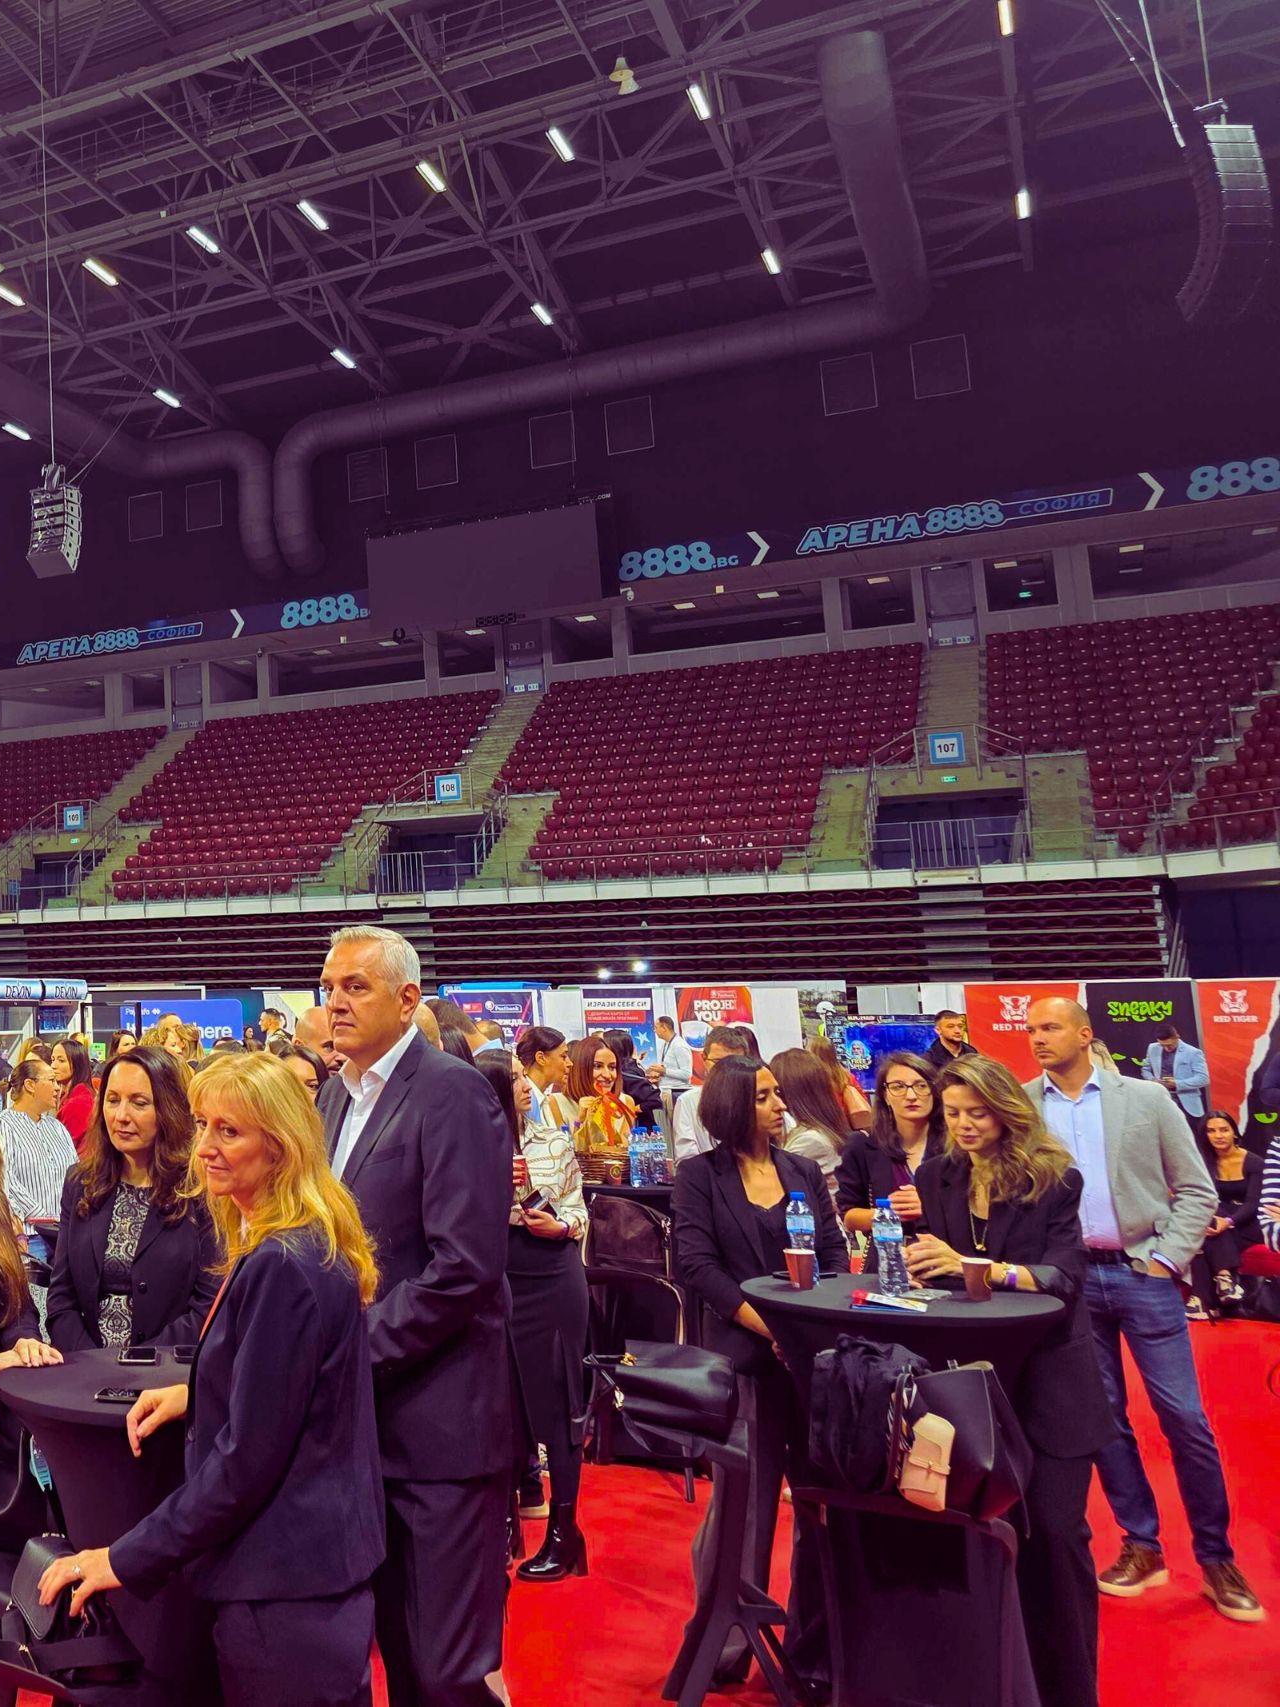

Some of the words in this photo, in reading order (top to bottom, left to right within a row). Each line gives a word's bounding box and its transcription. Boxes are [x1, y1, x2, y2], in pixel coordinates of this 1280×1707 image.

[798, 516, 922, 553] АРЕНА
[925, 501, 1004, 533] 8888
[1020, 493, 1100, 516] СОФИЯ
[619, 541, 739, 581] 8888.BG
[280, 593, 370, 629] 8888.B
[19, 636, 91, 664] АРЕНА
[93, 628, 139, 652] 8888
[148, 624, 196, 641] СОФИЯ
[937, 743, 955, 753] 107
[441, 784, 455, 792] 108
[5, 985, 32, 998] DEVIN
[55, 985, 78, 998] DEVIN
[1213, 1015, 1231, 1023] RED
[1231, 1015, 1259, 1023] TIGER
[992, 1023, 1013, 1031] RED
